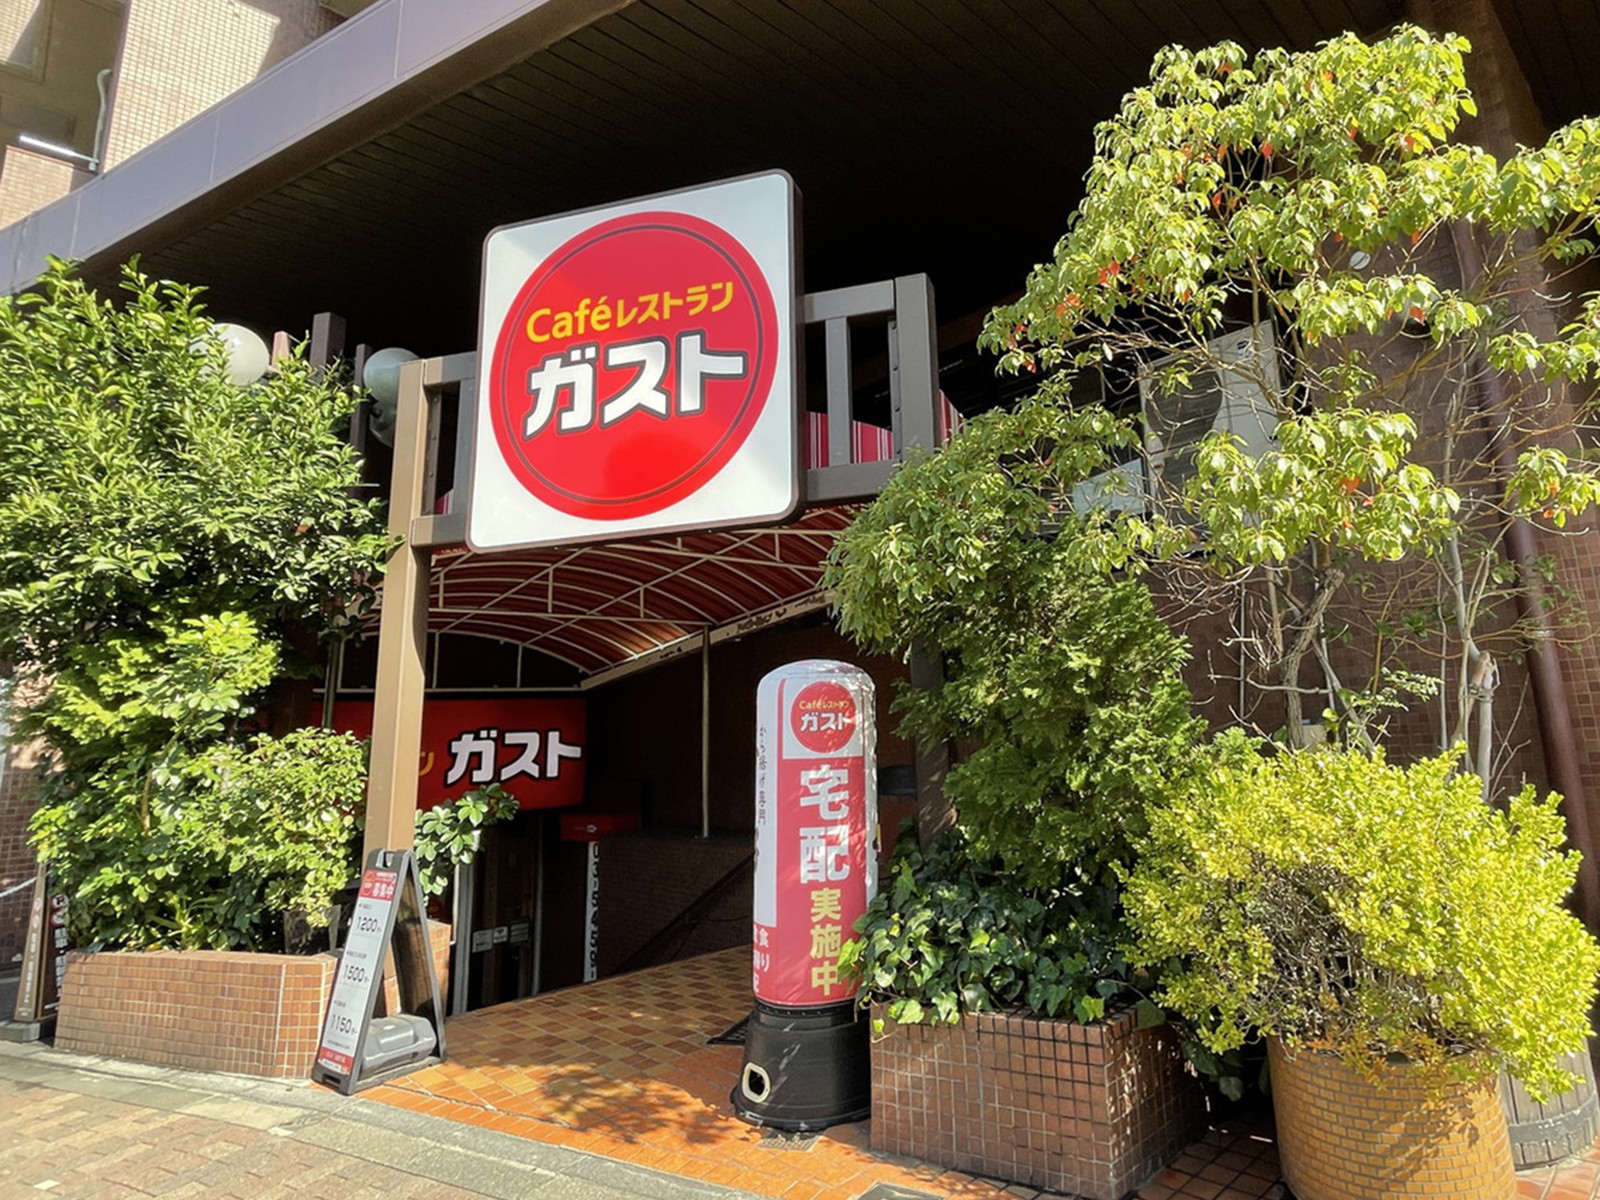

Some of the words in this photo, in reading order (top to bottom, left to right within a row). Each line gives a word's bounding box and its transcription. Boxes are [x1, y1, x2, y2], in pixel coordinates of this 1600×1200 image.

[523, 330, 746, 440] ガスト
[800, 711, 852, 732] ガスト
[446, 729, 582, 785] ガスト
